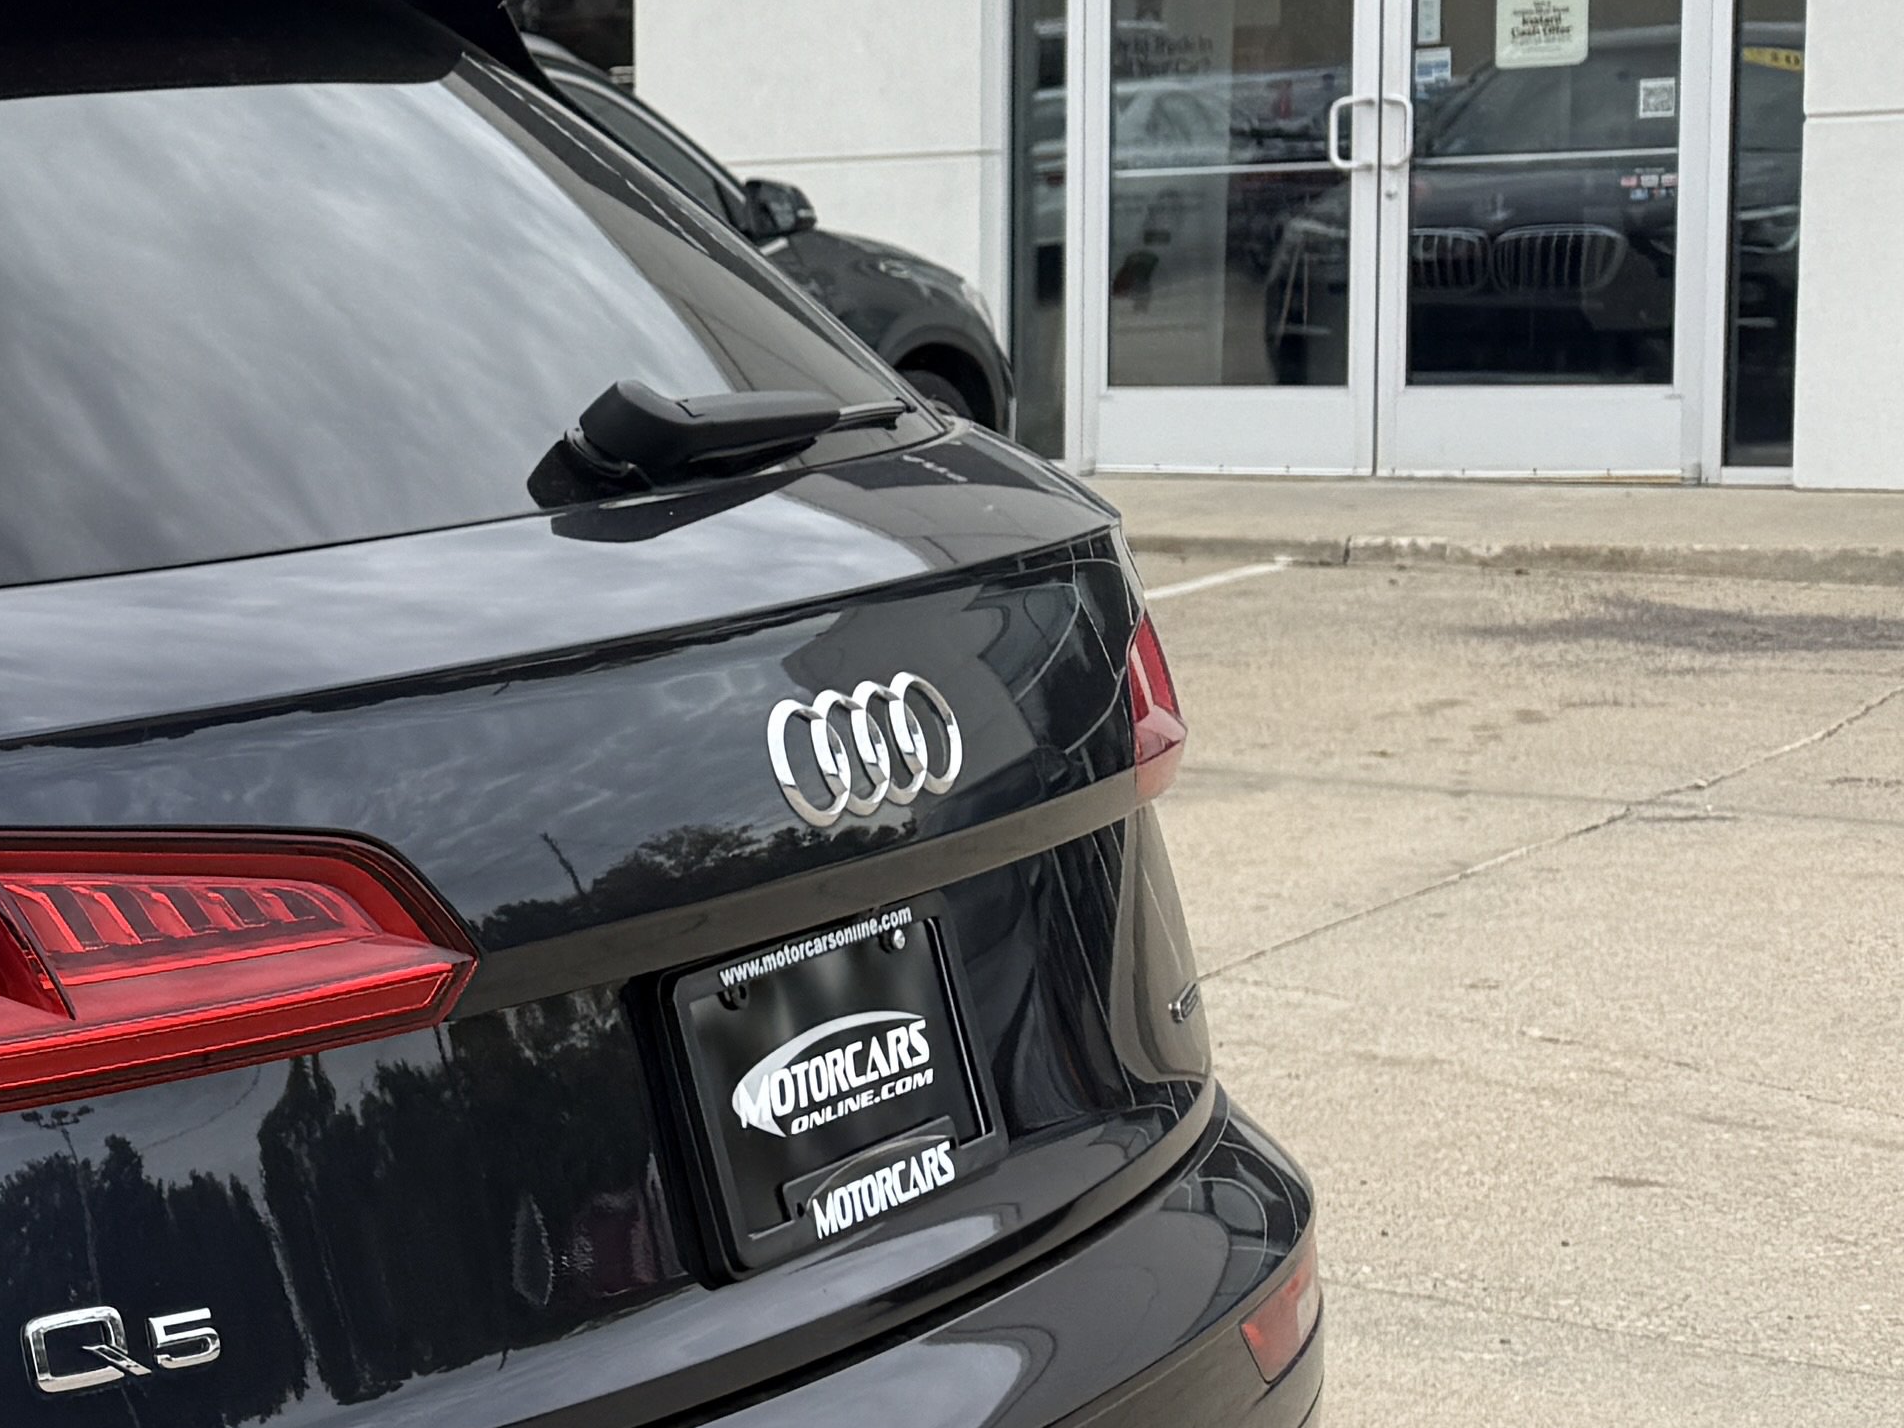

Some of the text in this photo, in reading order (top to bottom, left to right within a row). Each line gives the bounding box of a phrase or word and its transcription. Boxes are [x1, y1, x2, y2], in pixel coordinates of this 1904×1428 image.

[720, 906, 912, 987] www.motorcarsonline.com
[739, 1019, 930, 1129] MOTORCARS
[791, 1068, 934, 1135] ONLINE.COM
[812, 1140, 956, 1239] MOTORCARS
[22, 1305, 222, 1394] Q5
